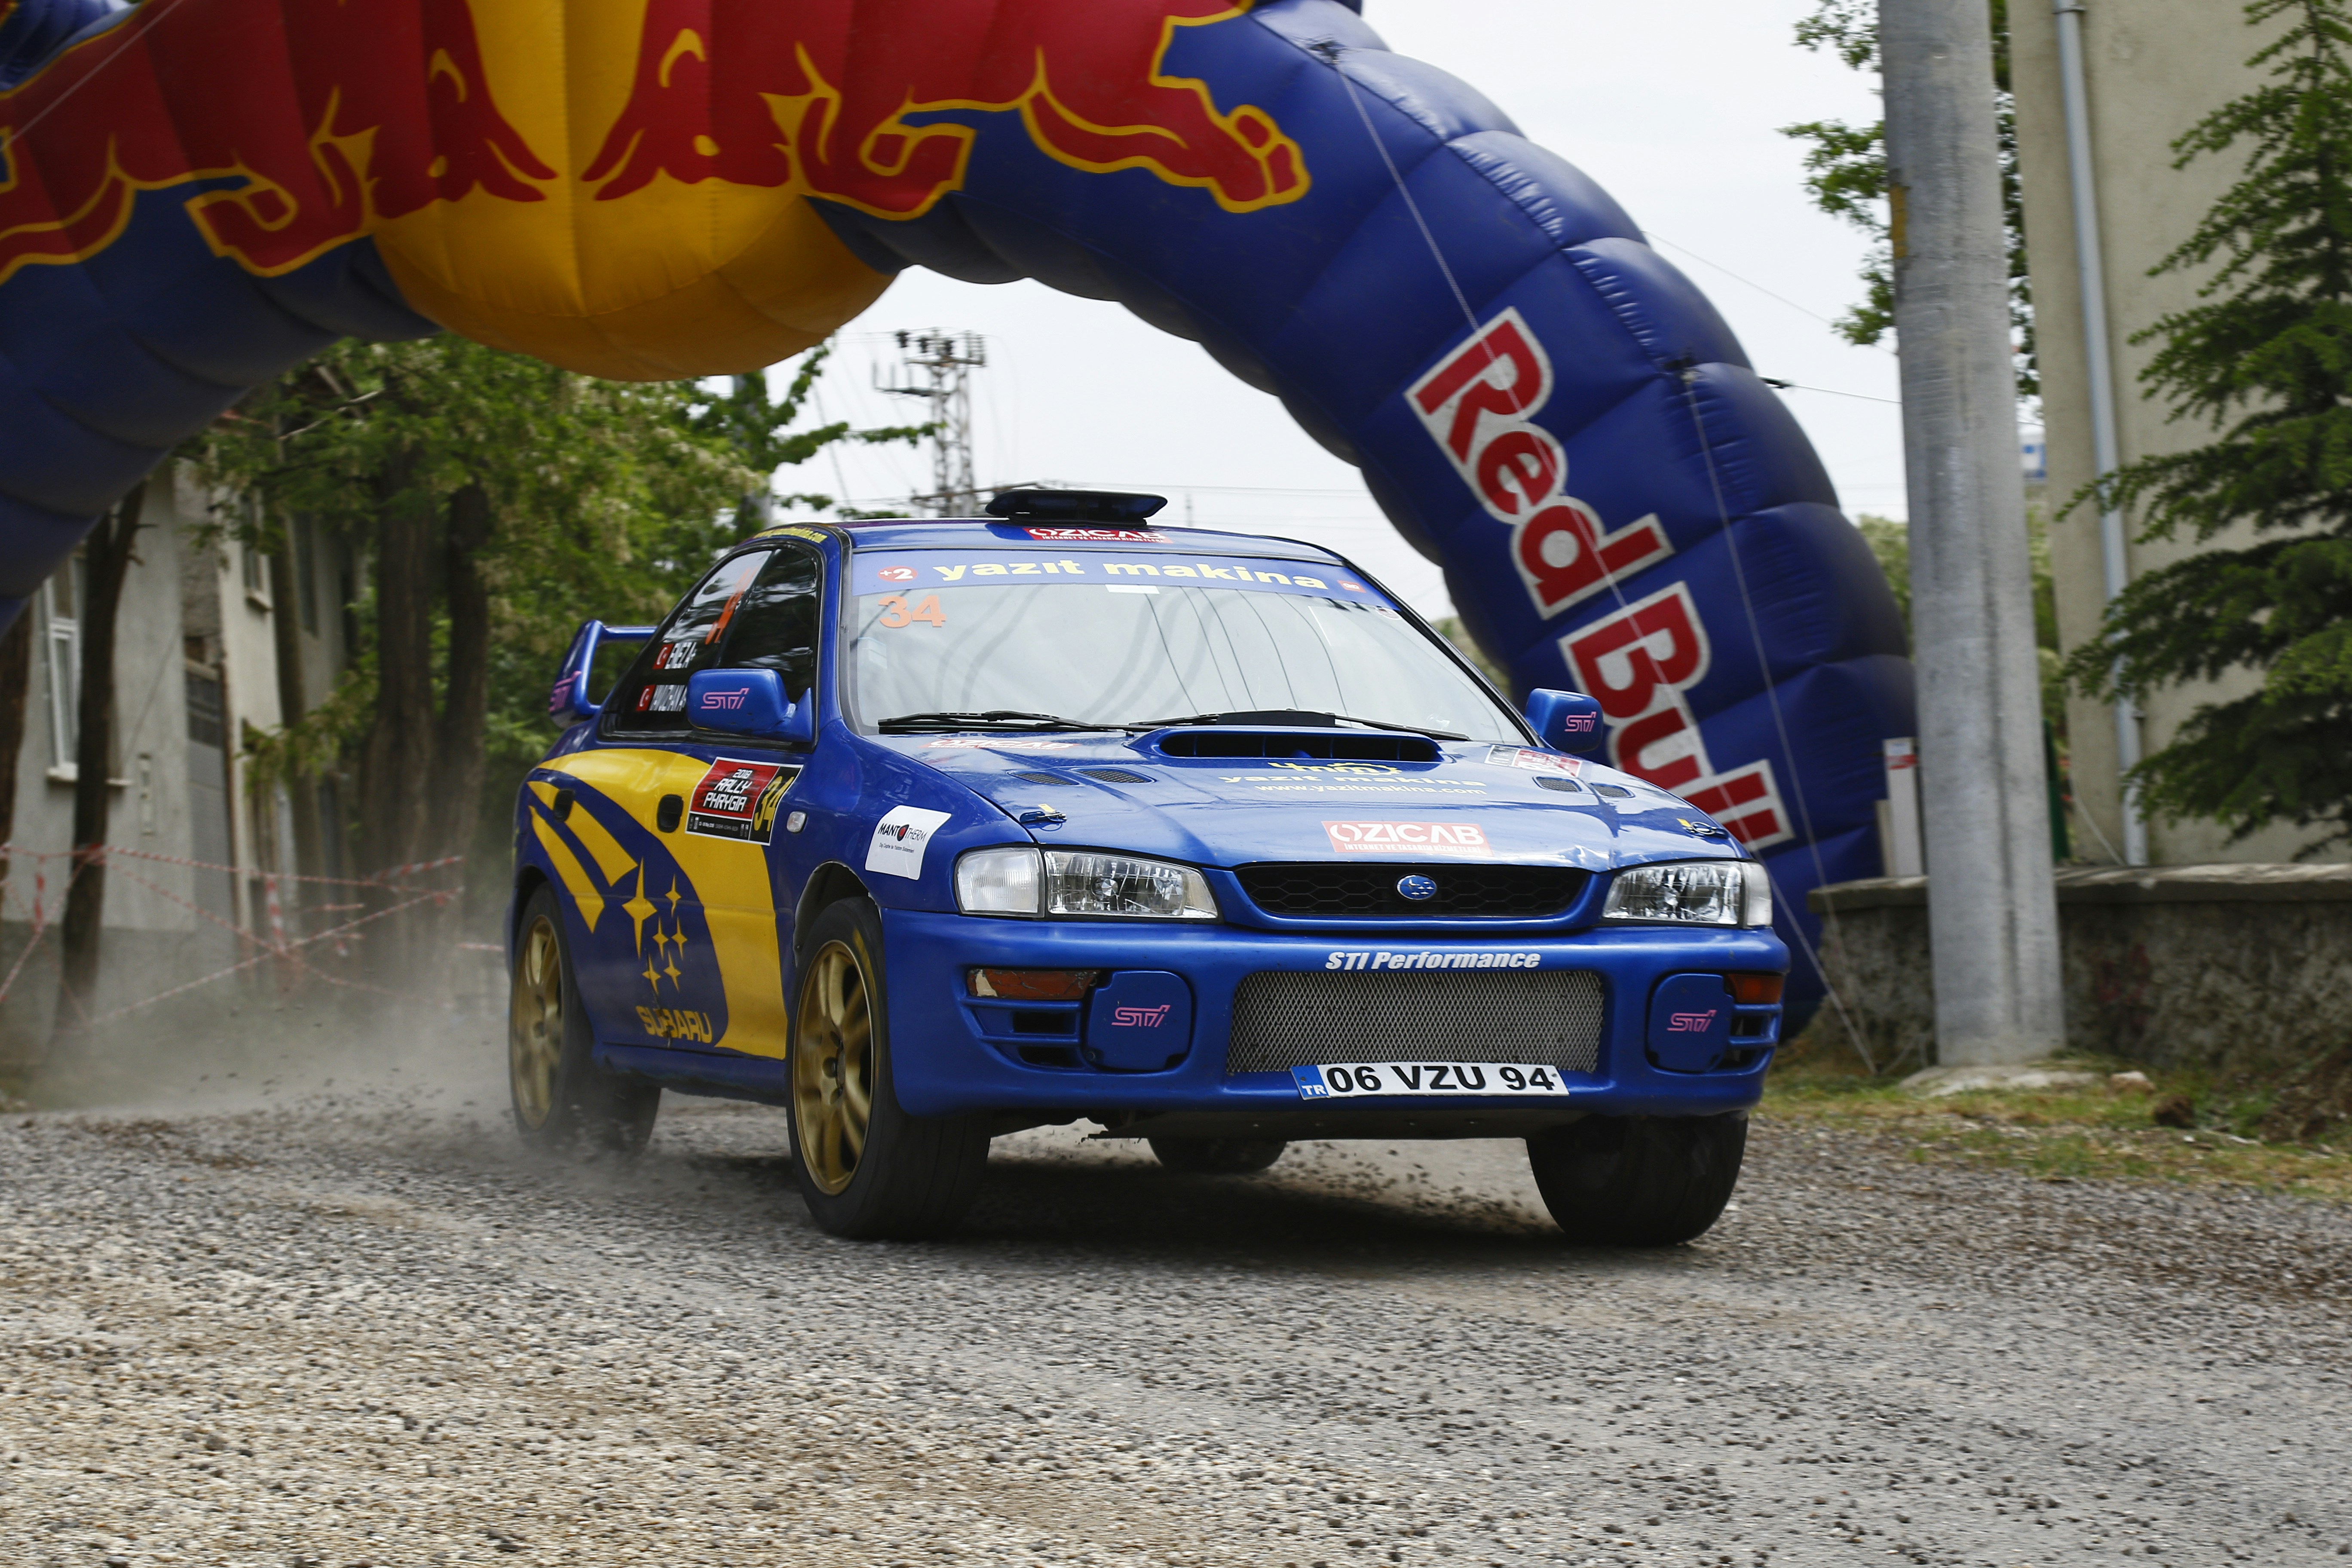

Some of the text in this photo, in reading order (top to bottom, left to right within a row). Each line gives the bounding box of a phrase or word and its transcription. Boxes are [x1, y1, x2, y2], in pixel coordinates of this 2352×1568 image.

[1103, 562, 1328, 589] makina
[1405, 307, 1794, 850] Red Bull
[878, 595, 946, 628] 34
[713, 778, 753, 794] RALLY
[732, 769, 753, 779] 2018
[1333, 777, 1487, 787] makina
[703, 792, 747, 812] PHRYGIA
[753, 775, 794, 832] 34
[1325, 951, 1541, 971] STI Performance
[636, 1005, 713, 1044] SUBARU
[1302, 1066, 1556, 1096] TR 06 VZU 94
